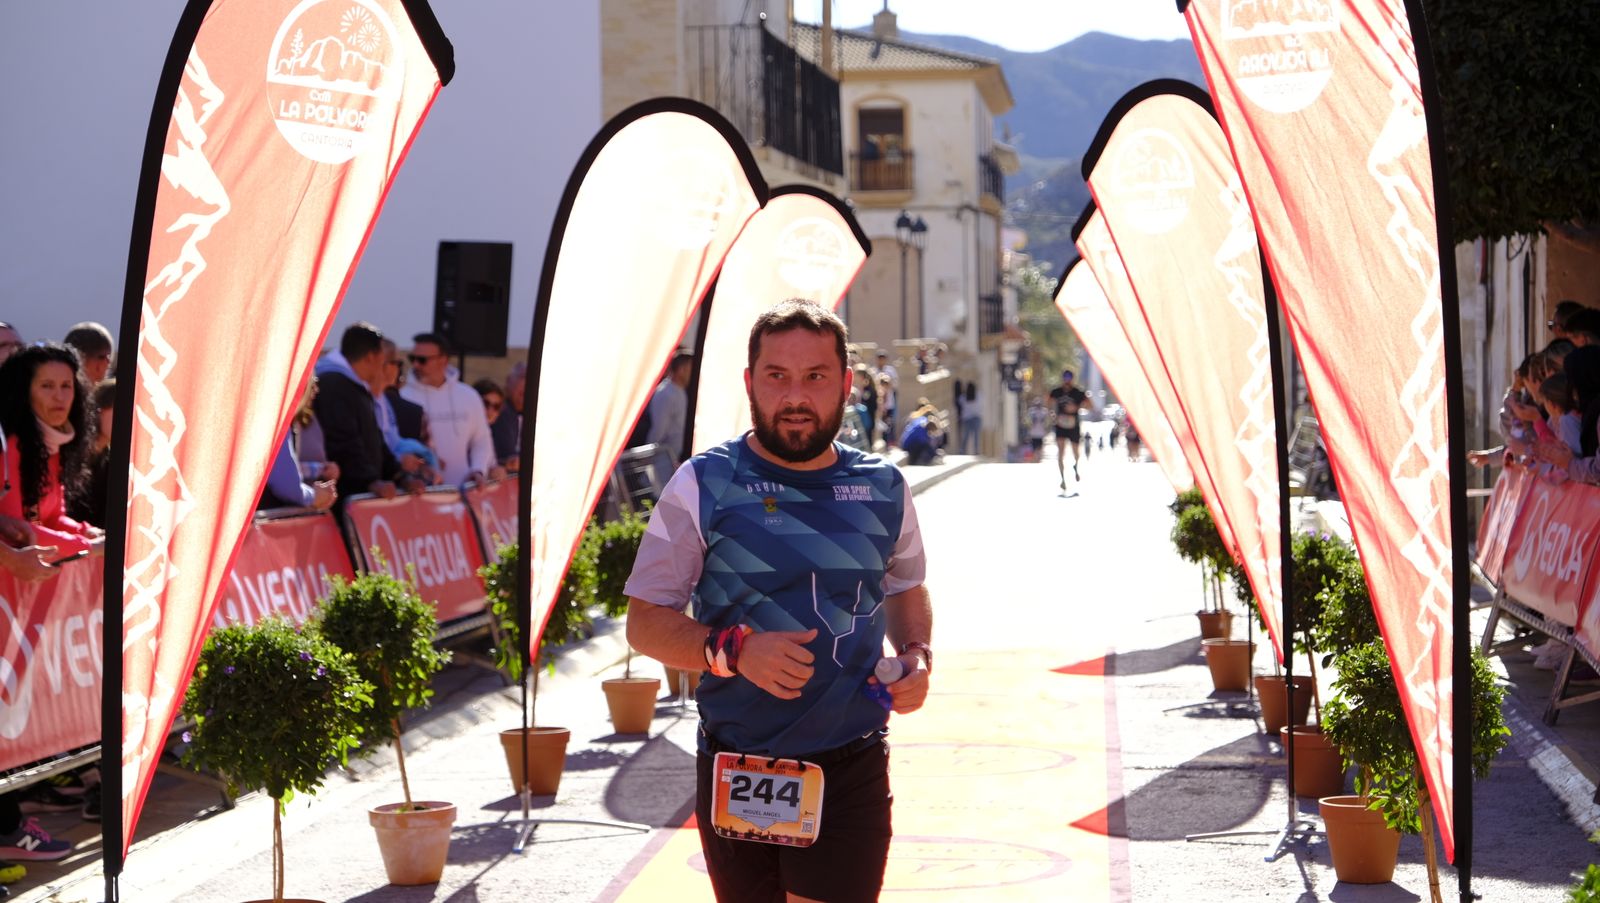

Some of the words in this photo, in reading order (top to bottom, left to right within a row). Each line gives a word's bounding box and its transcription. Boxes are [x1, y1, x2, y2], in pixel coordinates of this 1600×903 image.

[280, 99, 300, 118] LA
[304, 103, 368, 129] POLVOR
[398, 531, 471, 587] VEOLIA
[730, 775, 800, 808] 244
